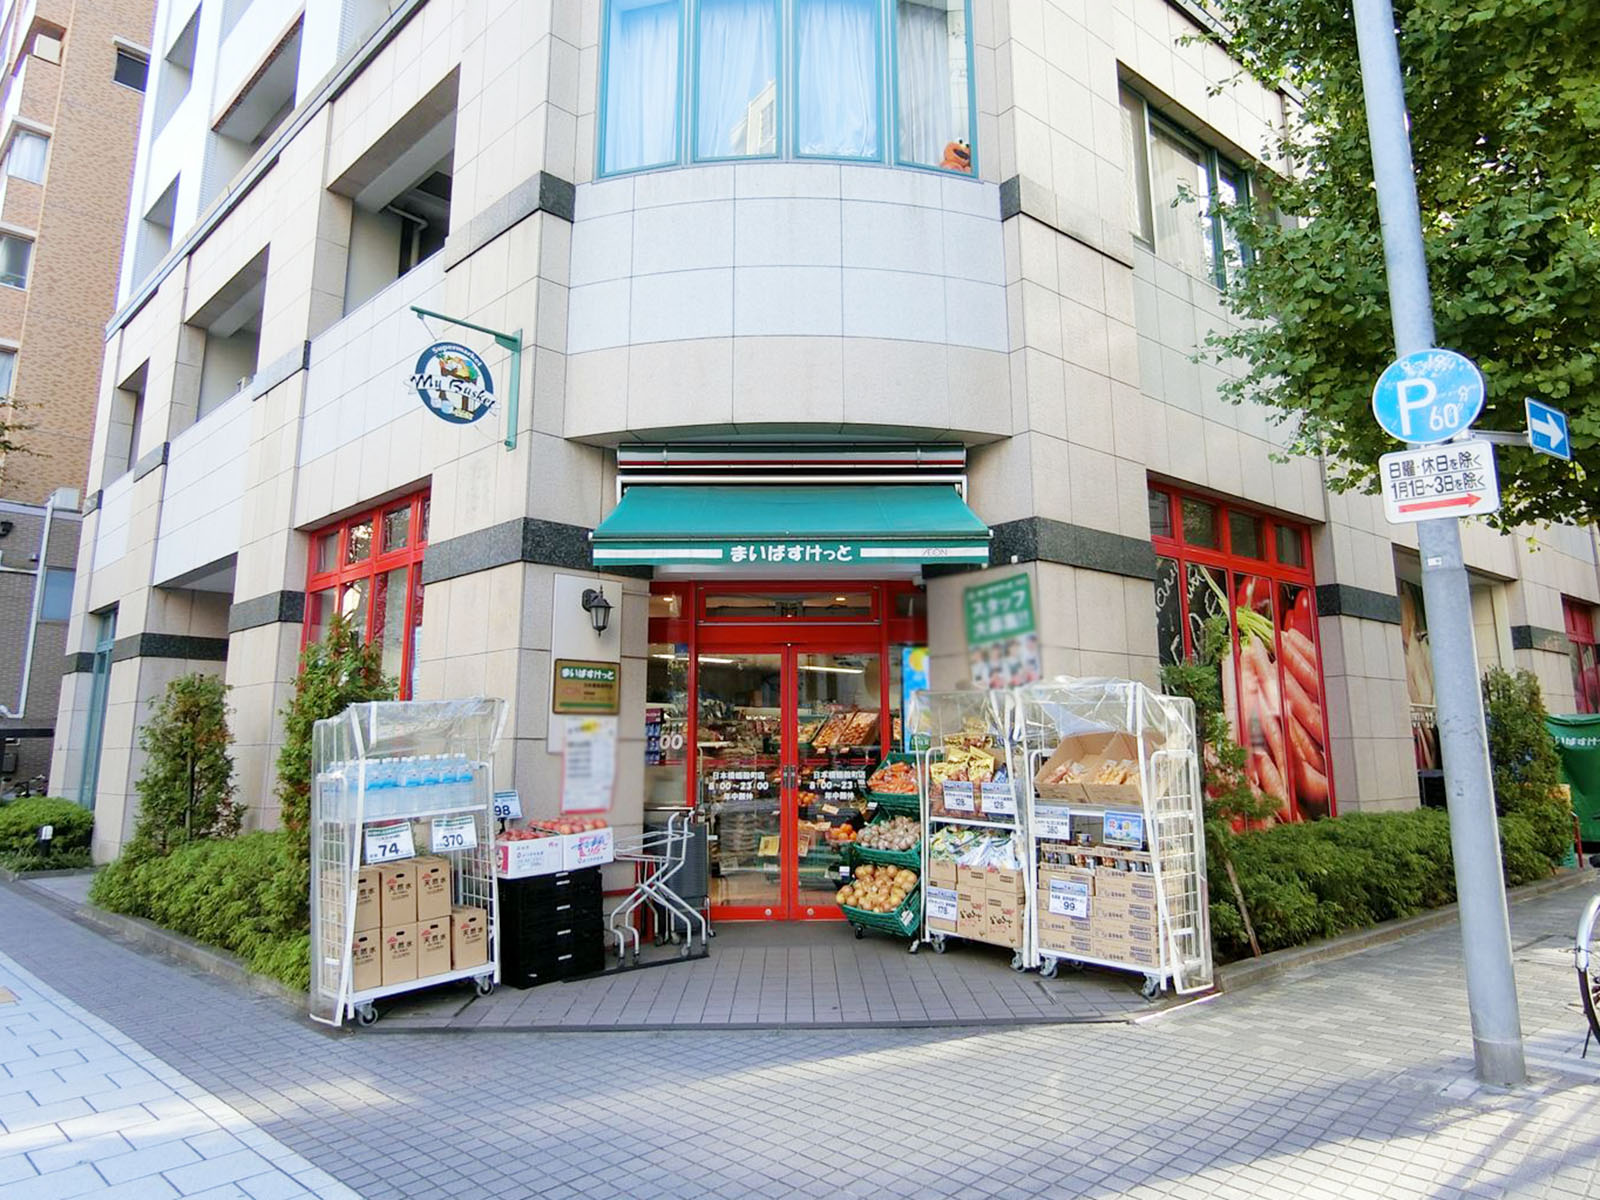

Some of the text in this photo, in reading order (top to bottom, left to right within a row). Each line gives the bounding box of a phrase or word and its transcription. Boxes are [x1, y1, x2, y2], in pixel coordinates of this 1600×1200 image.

[432, 344, 482, 367] Supermarket
[410, 374, 497, 408] My Basket
[1396, 377, 1437, 436] P
[730, 544, 853, 562] まいばすけっと
[442, 833, 464, 848] 370
[378, 843, 400, 857] 74
[1063, 901, 1076, 911] 99
